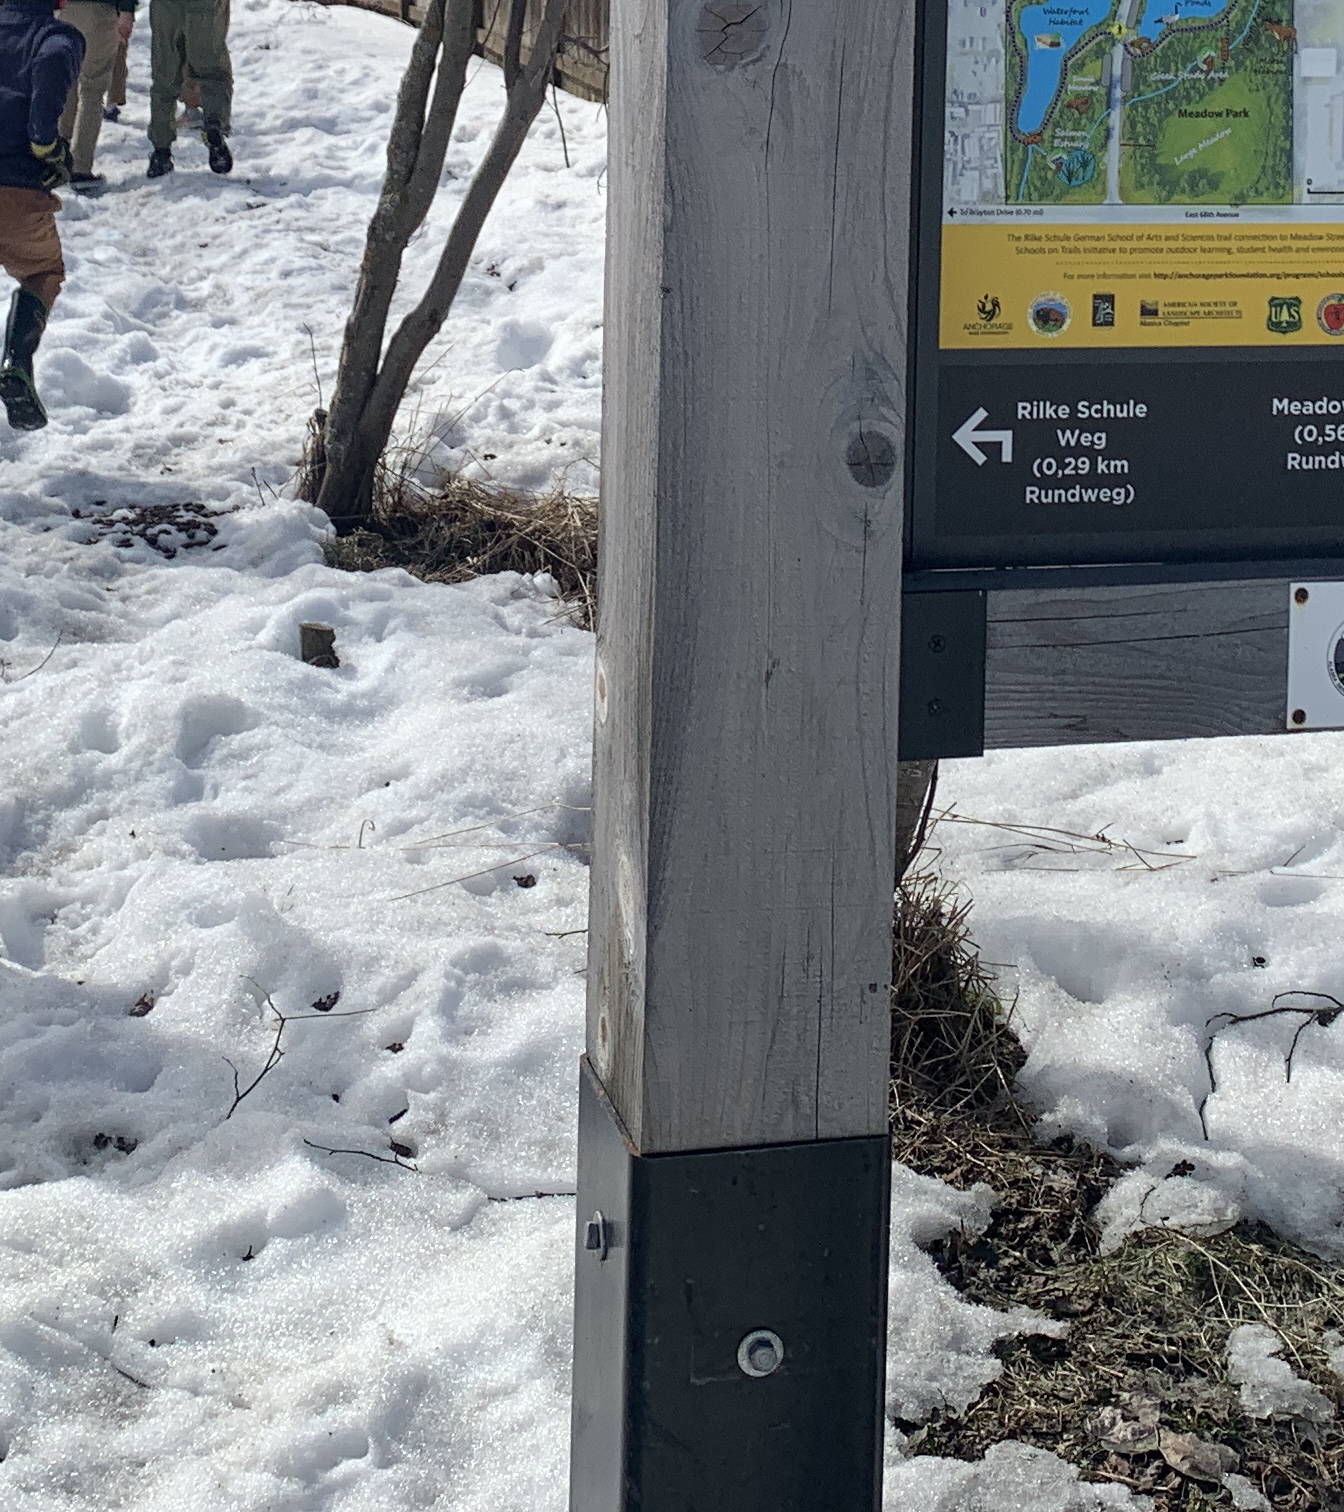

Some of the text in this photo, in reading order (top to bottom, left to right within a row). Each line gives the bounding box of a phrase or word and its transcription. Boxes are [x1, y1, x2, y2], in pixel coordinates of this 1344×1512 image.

[1176, 108, 1249, 118] Meadow Park
[1307, 178, 1313, 186] 0
[1018, 401, 1147, 419] Rilke Schule
[1057, 430, 1106, 449] Weg
[1033, 457, 1128, 477] (0,29 km
[1026, 485, 1134, 504] Rundweg)
